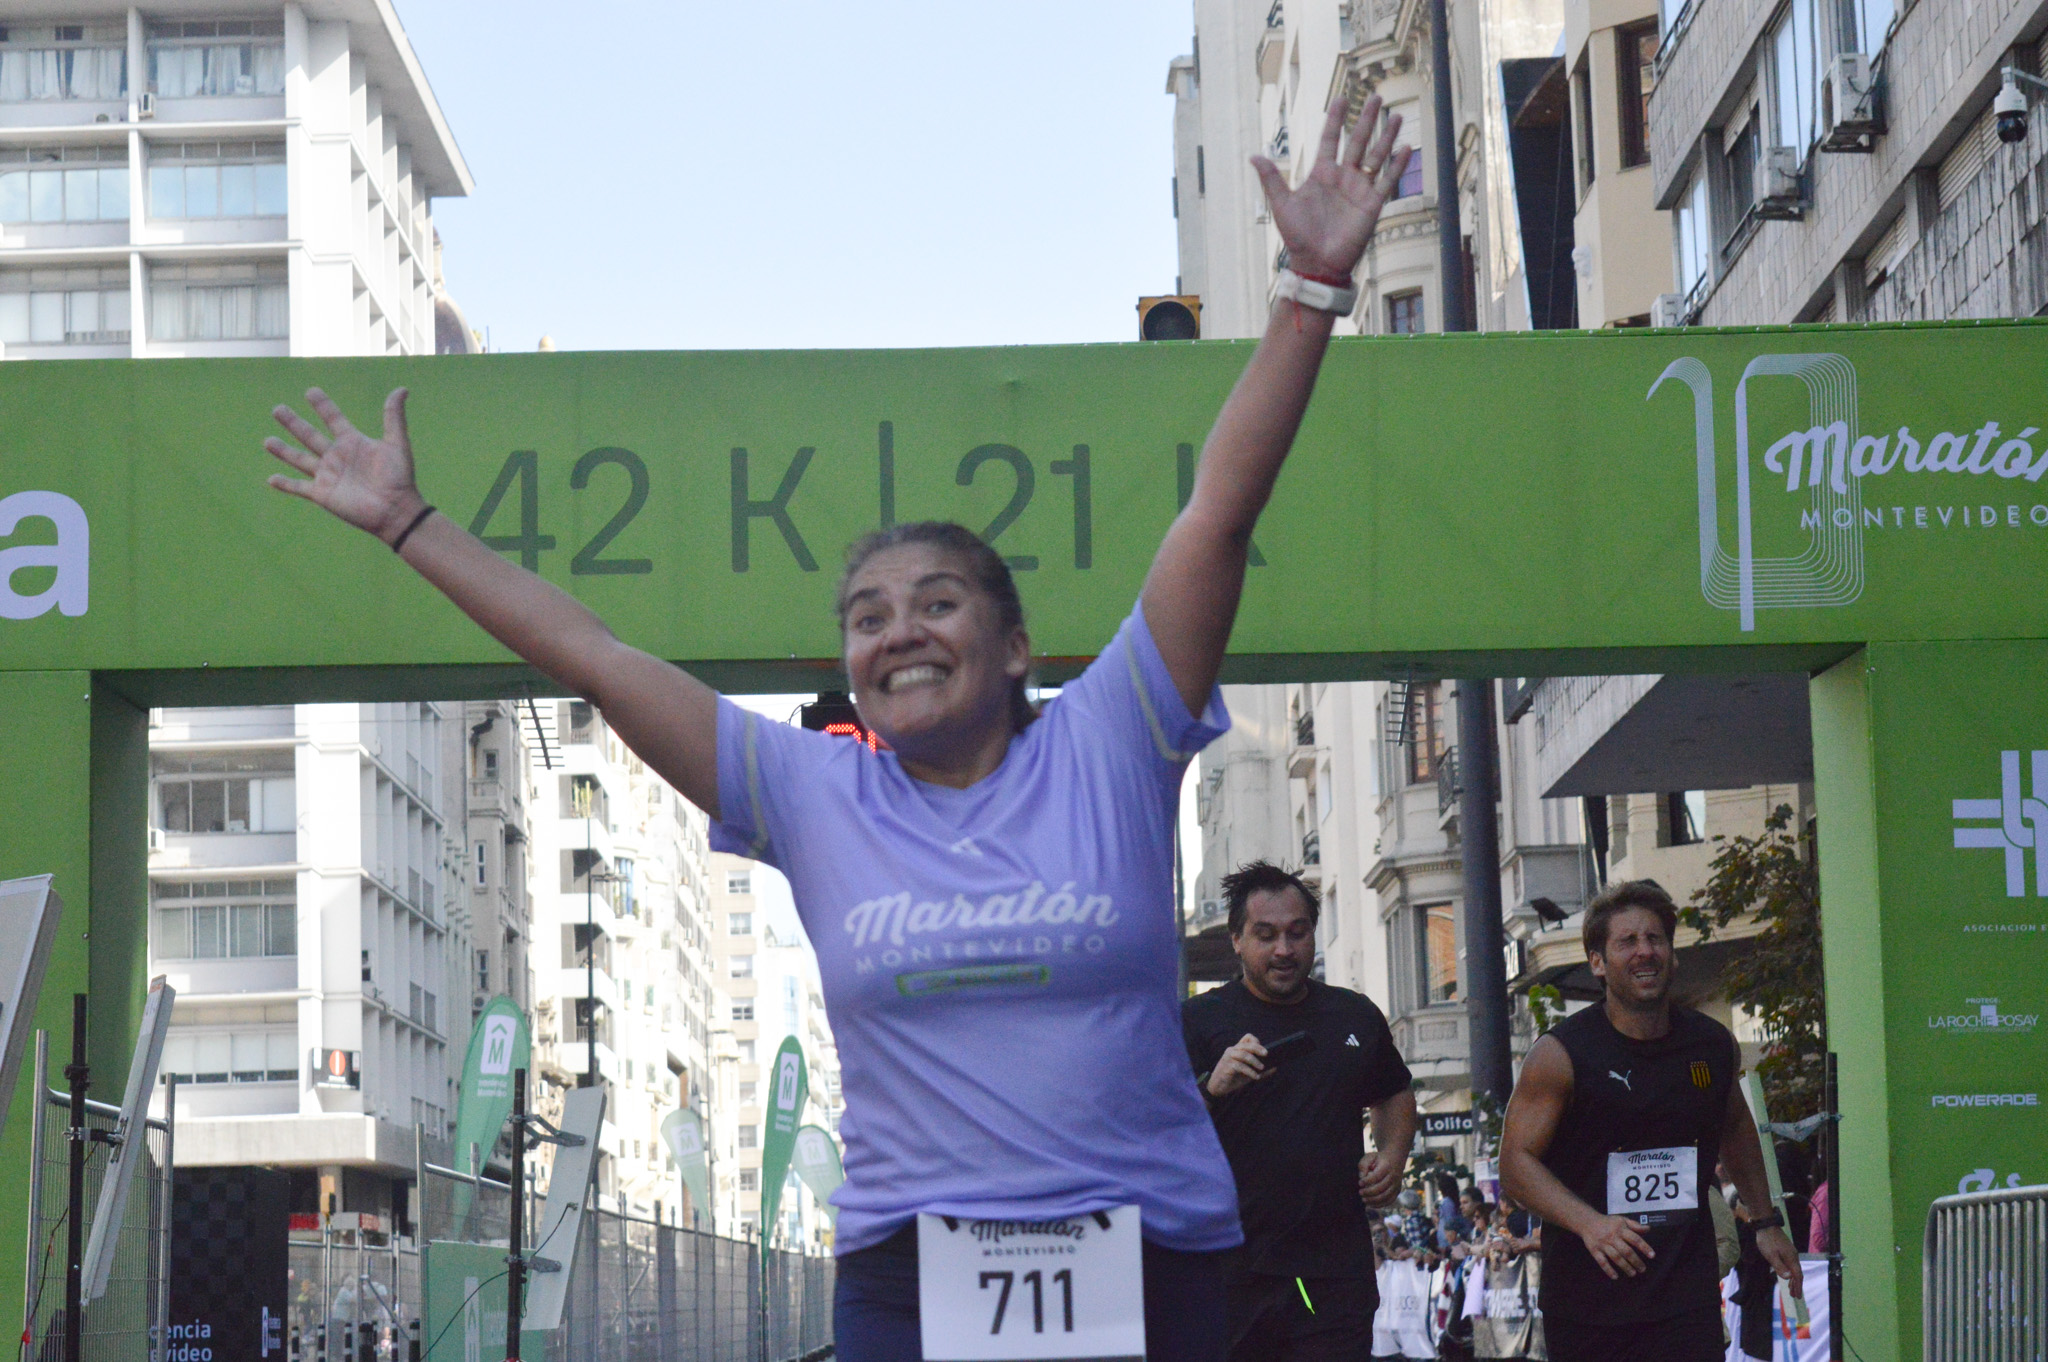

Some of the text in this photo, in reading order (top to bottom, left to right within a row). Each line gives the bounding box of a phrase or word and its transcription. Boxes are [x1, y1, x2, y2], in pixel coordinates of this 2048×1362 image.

[467, 446, 653, 575] 42
[729, 446, 820, 573] K
[954, 443, 1091, 571] 21
[1800, 503, 2048, 530] MONTEVIDEO
[844, 880, 1120, 948] Maratón
[1963, 924, 2036, 932] ASOCIACION
[855, 934, 1105, 975] MONTEVIDEO
[1932, 1093, 2038, 1107] POWERADE
[1426, 1116, 1472, 1131] Lolita
[1625, 1171, 1679, 1203] 825
[982, 1244, 1077, 1257] MONTEVIDEO
[978, 1268, 1073, 1335] 711
